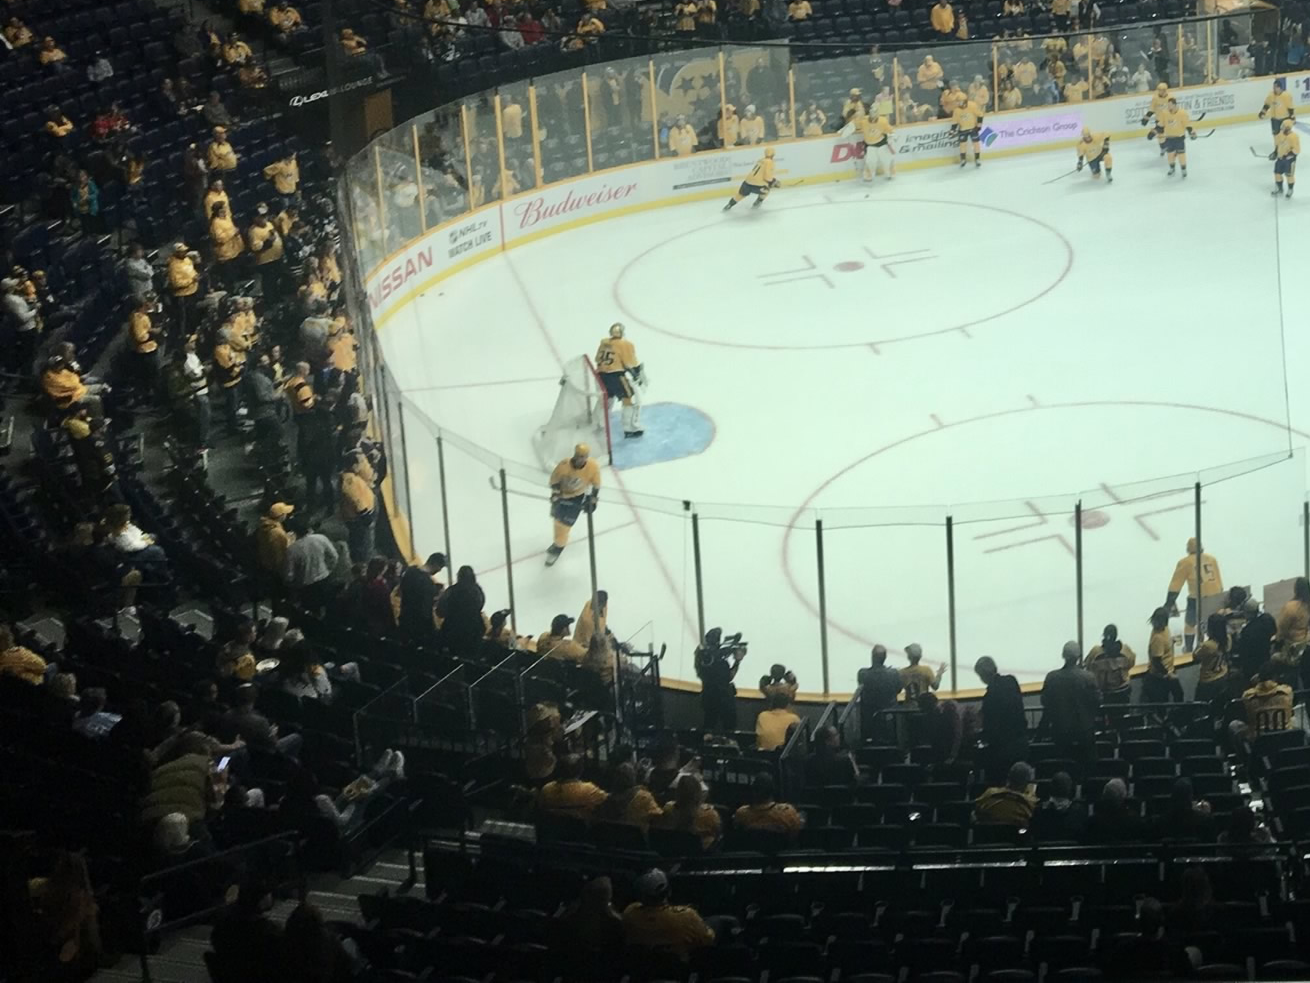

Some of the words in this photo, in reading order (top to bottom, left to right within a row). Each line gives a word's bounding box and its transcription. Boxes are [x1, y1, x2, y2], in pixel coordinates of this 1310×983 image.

[1000, 129, 1015, 139] The
[1052, 121, 1078, 131] Group
[513, 182, 638, 229] Budweiser
[448, 239, 473, 259] WATCH
[475, 231, 492, 249] LIVE
